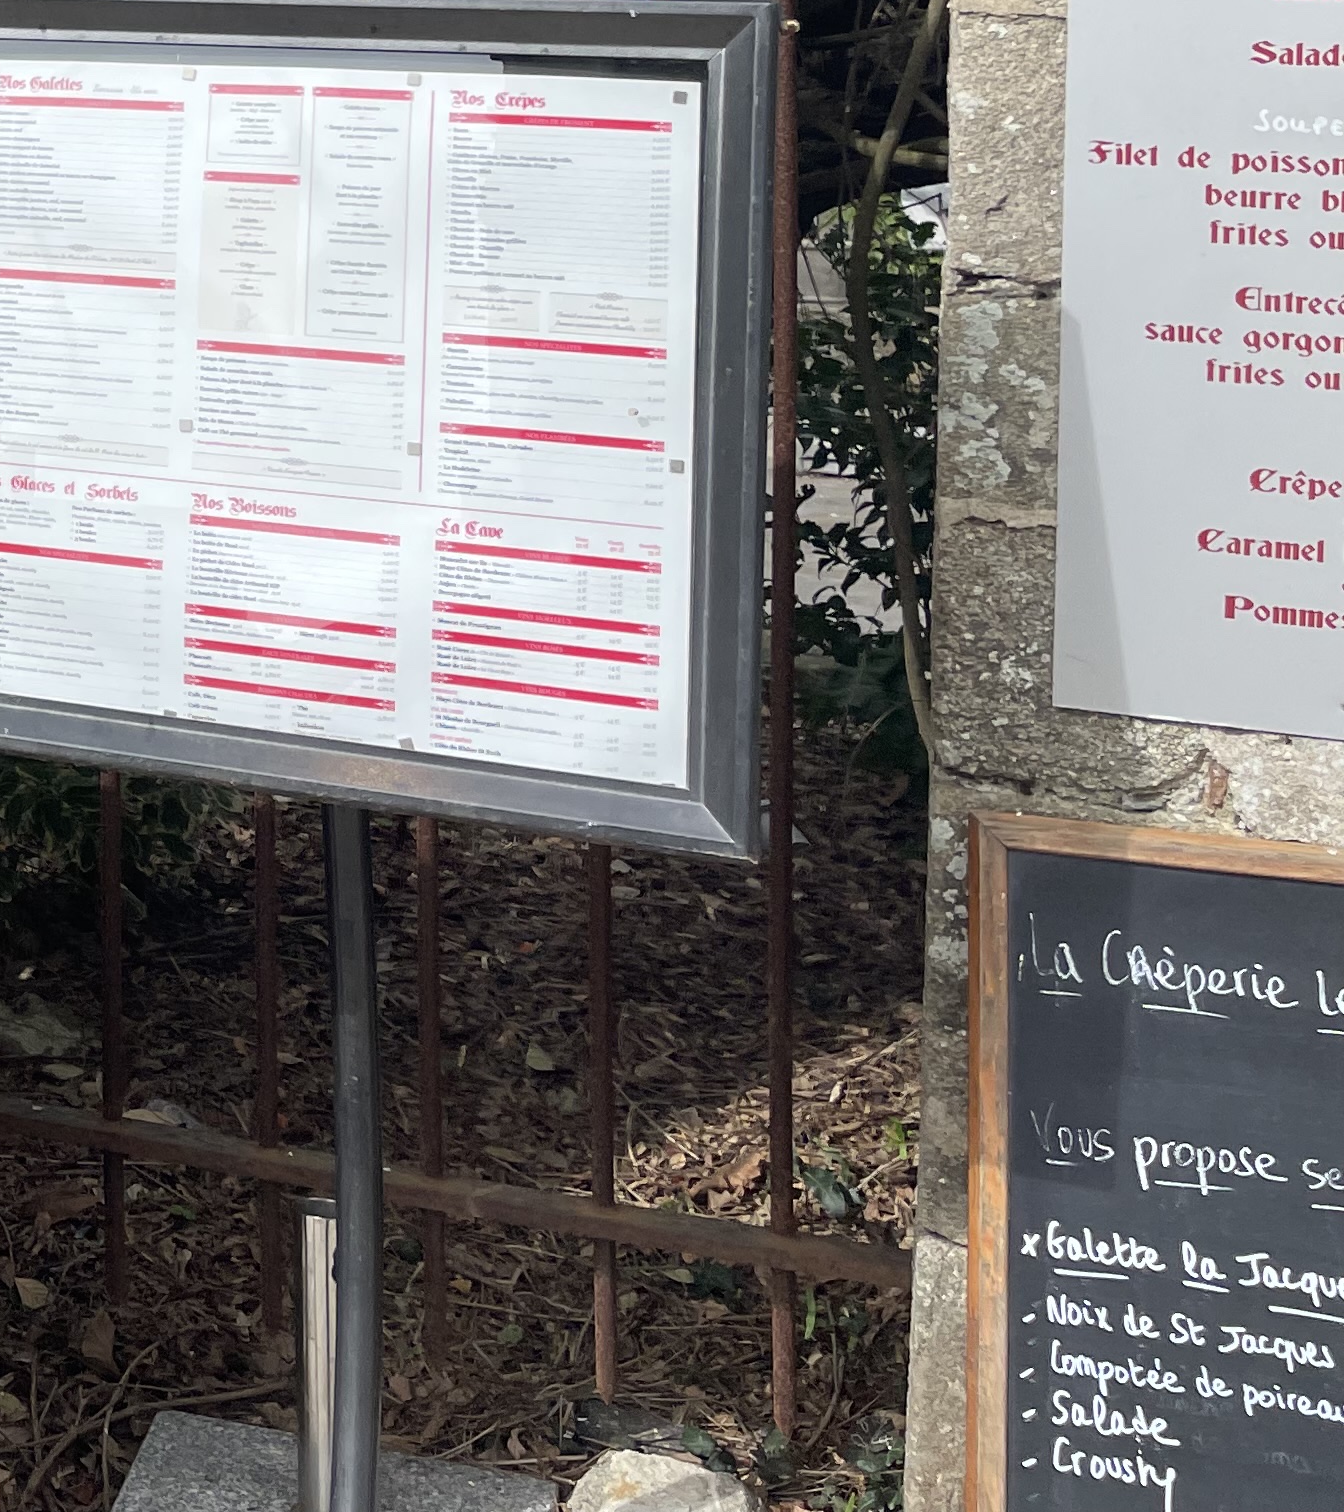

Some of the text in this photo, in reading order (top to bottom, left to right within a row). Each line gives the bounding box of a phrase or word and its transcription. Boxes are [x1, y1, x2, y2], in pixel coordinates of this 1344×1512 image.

[0, 74, 26, 92] Nos
[29, 75, 83, 93] Galettes
[450, 89, 485, 109] Nos
[1088, 140, 1158, 167] Filet
[1177, 145, 1212, 169] de
[1204, 183, 1302, 211] beurre
[1209, 220, 1344, 250] frites ou
[1144, 322, 1224, 345] sauce
[1205, 358, 1341, 391] frites ou
[191, 492, 297, 518] Nos Boissons
[435, 517, 504, 540] La Cave
[1196, 528, 1325, 564] Caramel
[1028, 911, 1084, 984] La
[1030, 1101, 1116, 1161] Vous
[1132, 1136, 1289, 1196] propose
[1046, 1219, 1167, 1272] Galette
[1180, 1240, 1227, 1280] la
[1045, 1293, 1336, 1374] Noix de St Jacques
[1195, 1364, 1234, 1398] de
[1050, 1389, 1181, 1447] Salade
